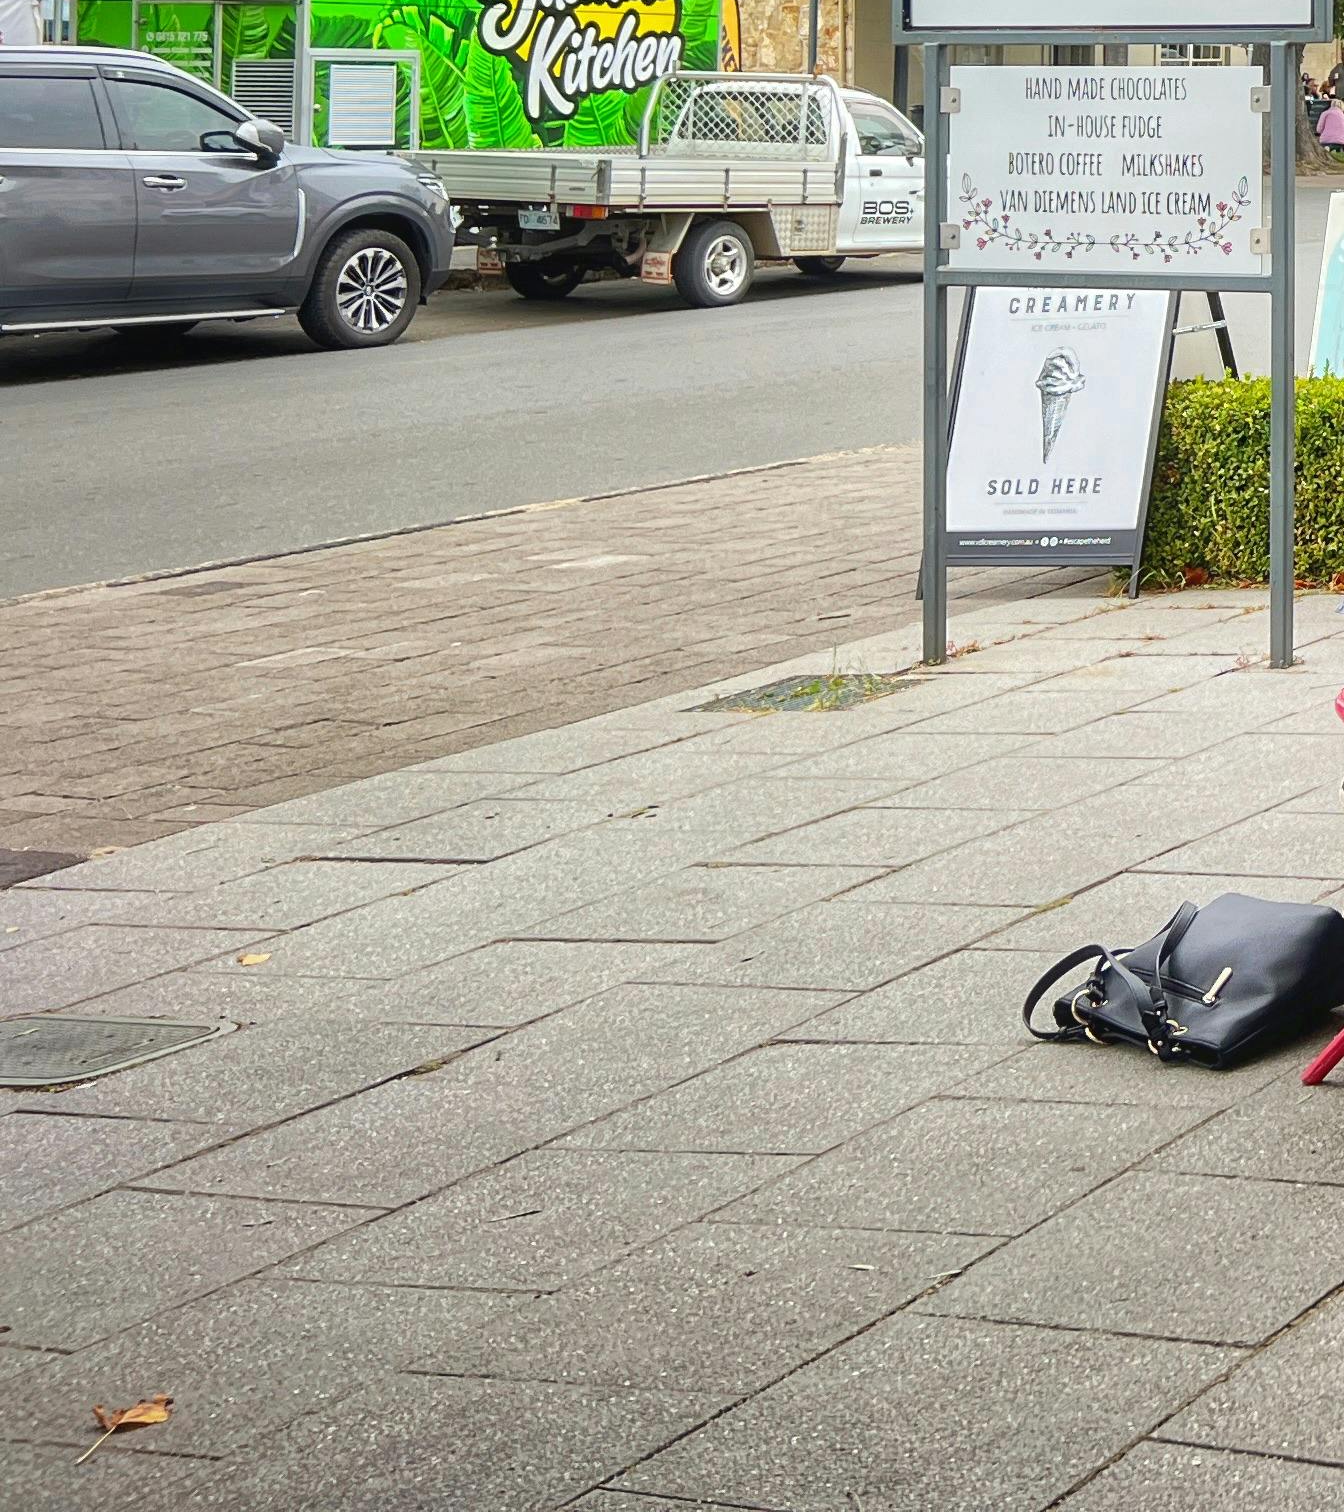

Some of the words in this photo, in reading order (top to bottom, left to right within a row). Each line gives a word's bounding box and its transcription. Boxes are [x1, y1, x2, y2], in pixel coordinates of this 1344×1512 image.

[527, 14, 682, 119] Kitchen
[1025, 77, 1062, 100] HAND
[1067, 77, 1105, 100] MADE
[1110, 77, 1187, 101] CHOCOLATES
[1047, 115, 1117, 139] IN-HOUSE
[1122, 115, 1163, 139] FUDGE
[1008, 152, 1055, 176] BOTERO
[1059, 152, 1103, 176] COFFEE
[1122, 153, 1205, 177] MILKSHAKES
[1000, 189, 1028, 213] VAN
[1034, 190, 1096, 214] DIEMENS
[1101, 191, 1137, 215] LAND
[1141, 192, 1161, 215] ICE
[1167, 192, 1212, 216] CREAM
[860, 216, 913, 224] BREWERY
[1009, 292, 1136, 314] CREAMERY
[987, 479, 1040, 496] SOLD
[1051, 477, 1103, 495] HERE
